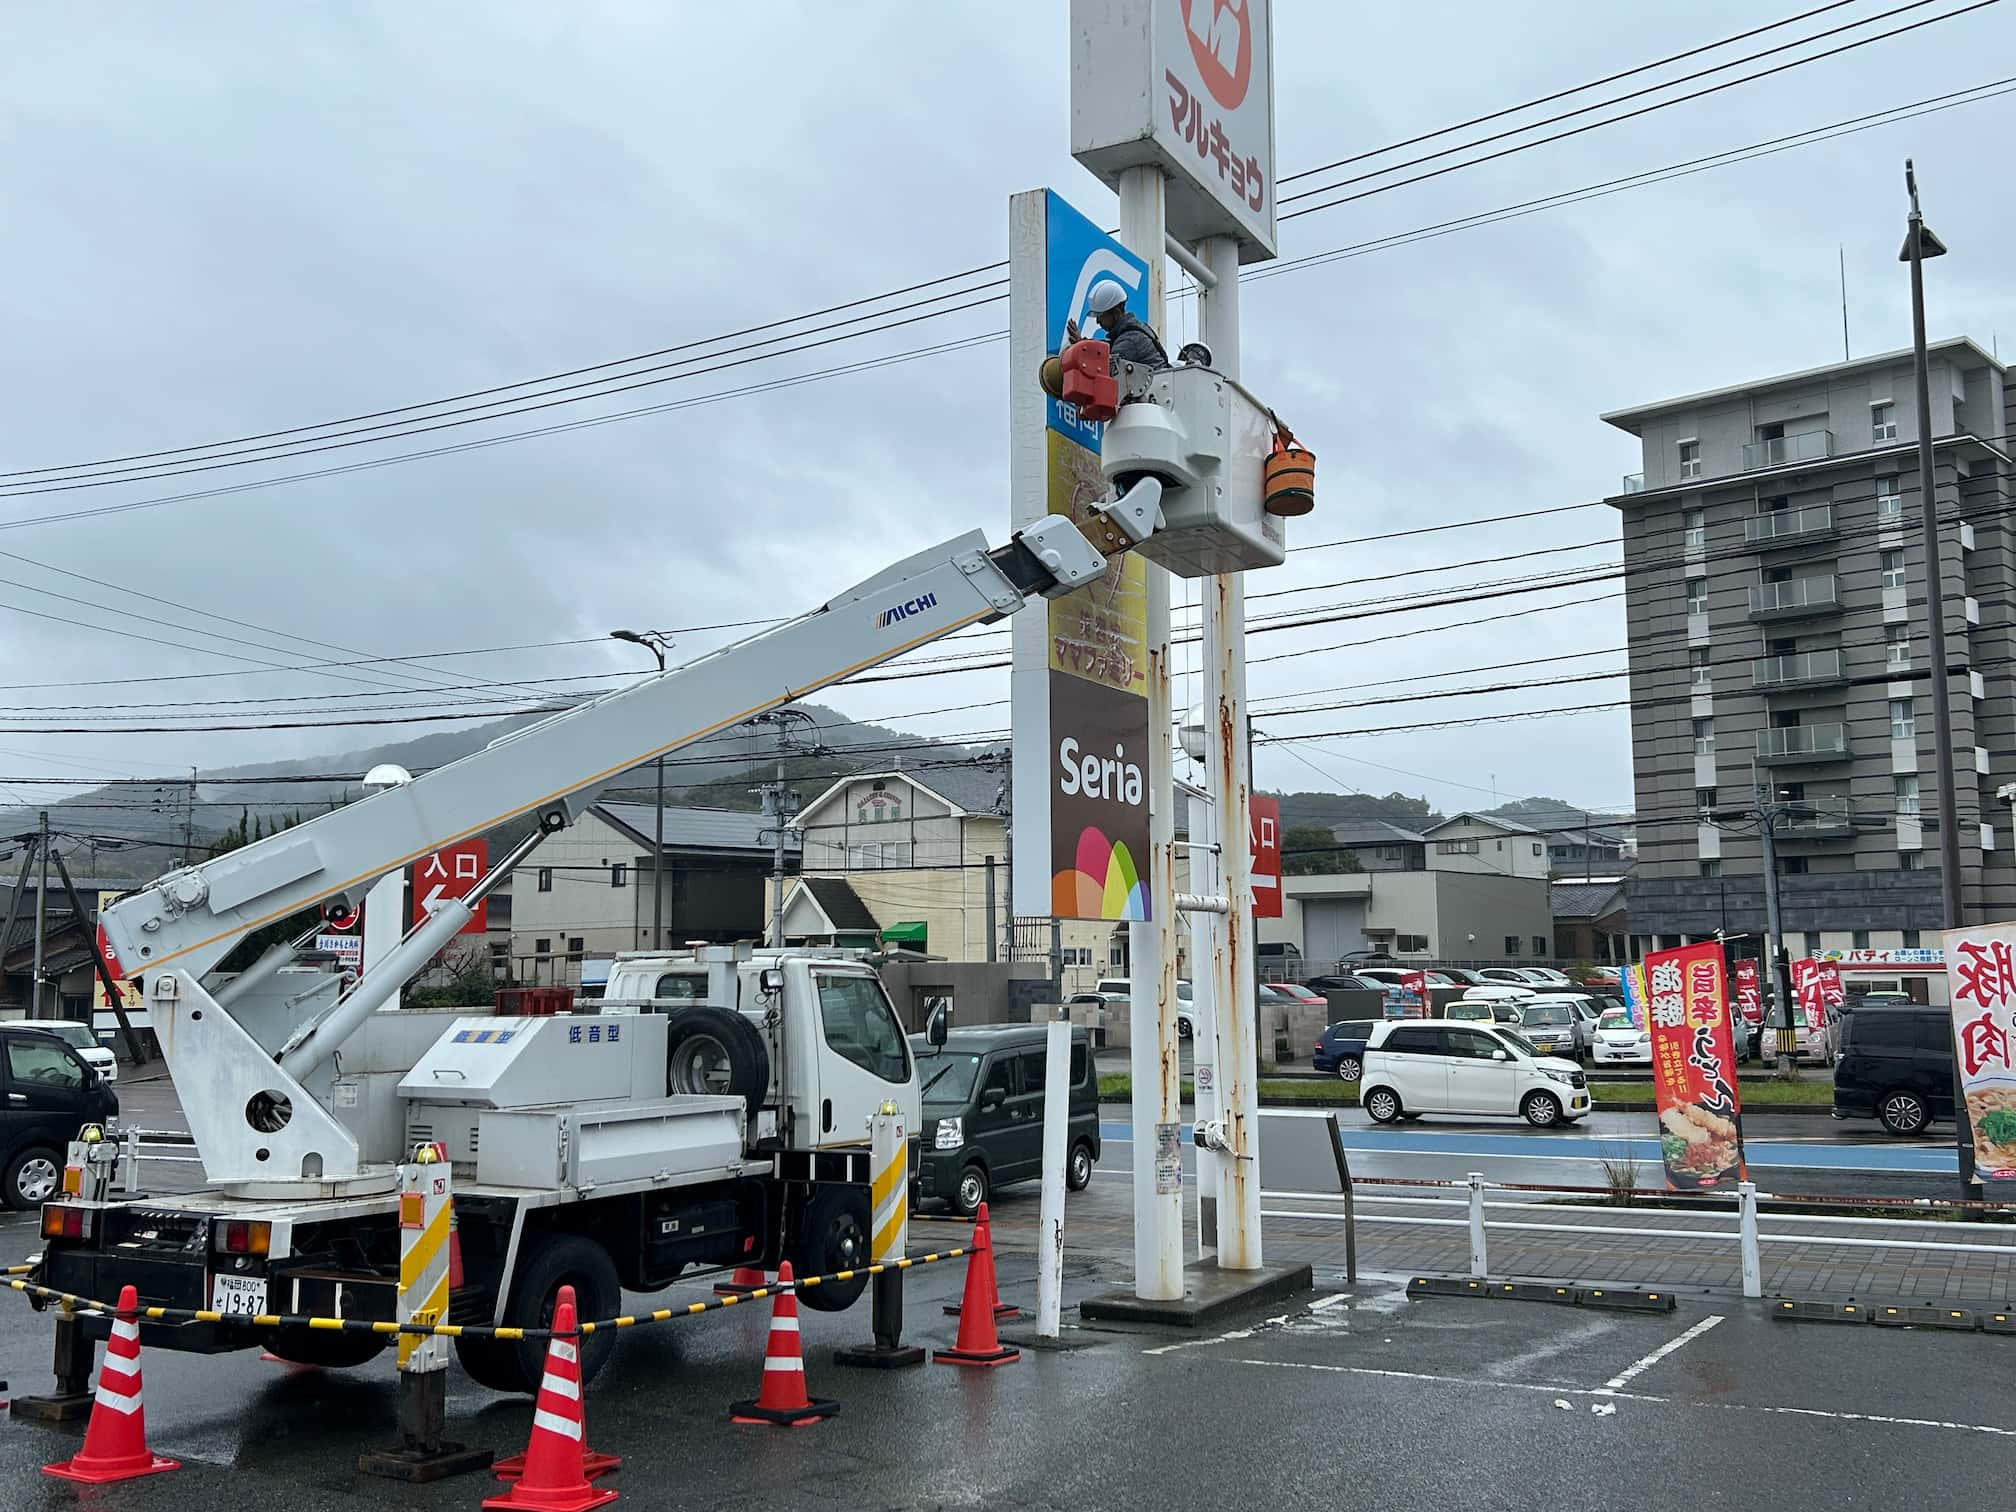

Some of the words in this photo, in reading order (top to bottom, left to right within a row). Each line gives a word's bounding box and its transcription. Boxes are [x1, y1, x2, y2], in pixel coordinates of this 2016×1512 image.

[1165, 67, 1264, 213] マルキョウ
[885, 592, 937, 626] AICHI
[1059, 737, 1143, 806] Seria
[423, 852, 478, 880] 入口
